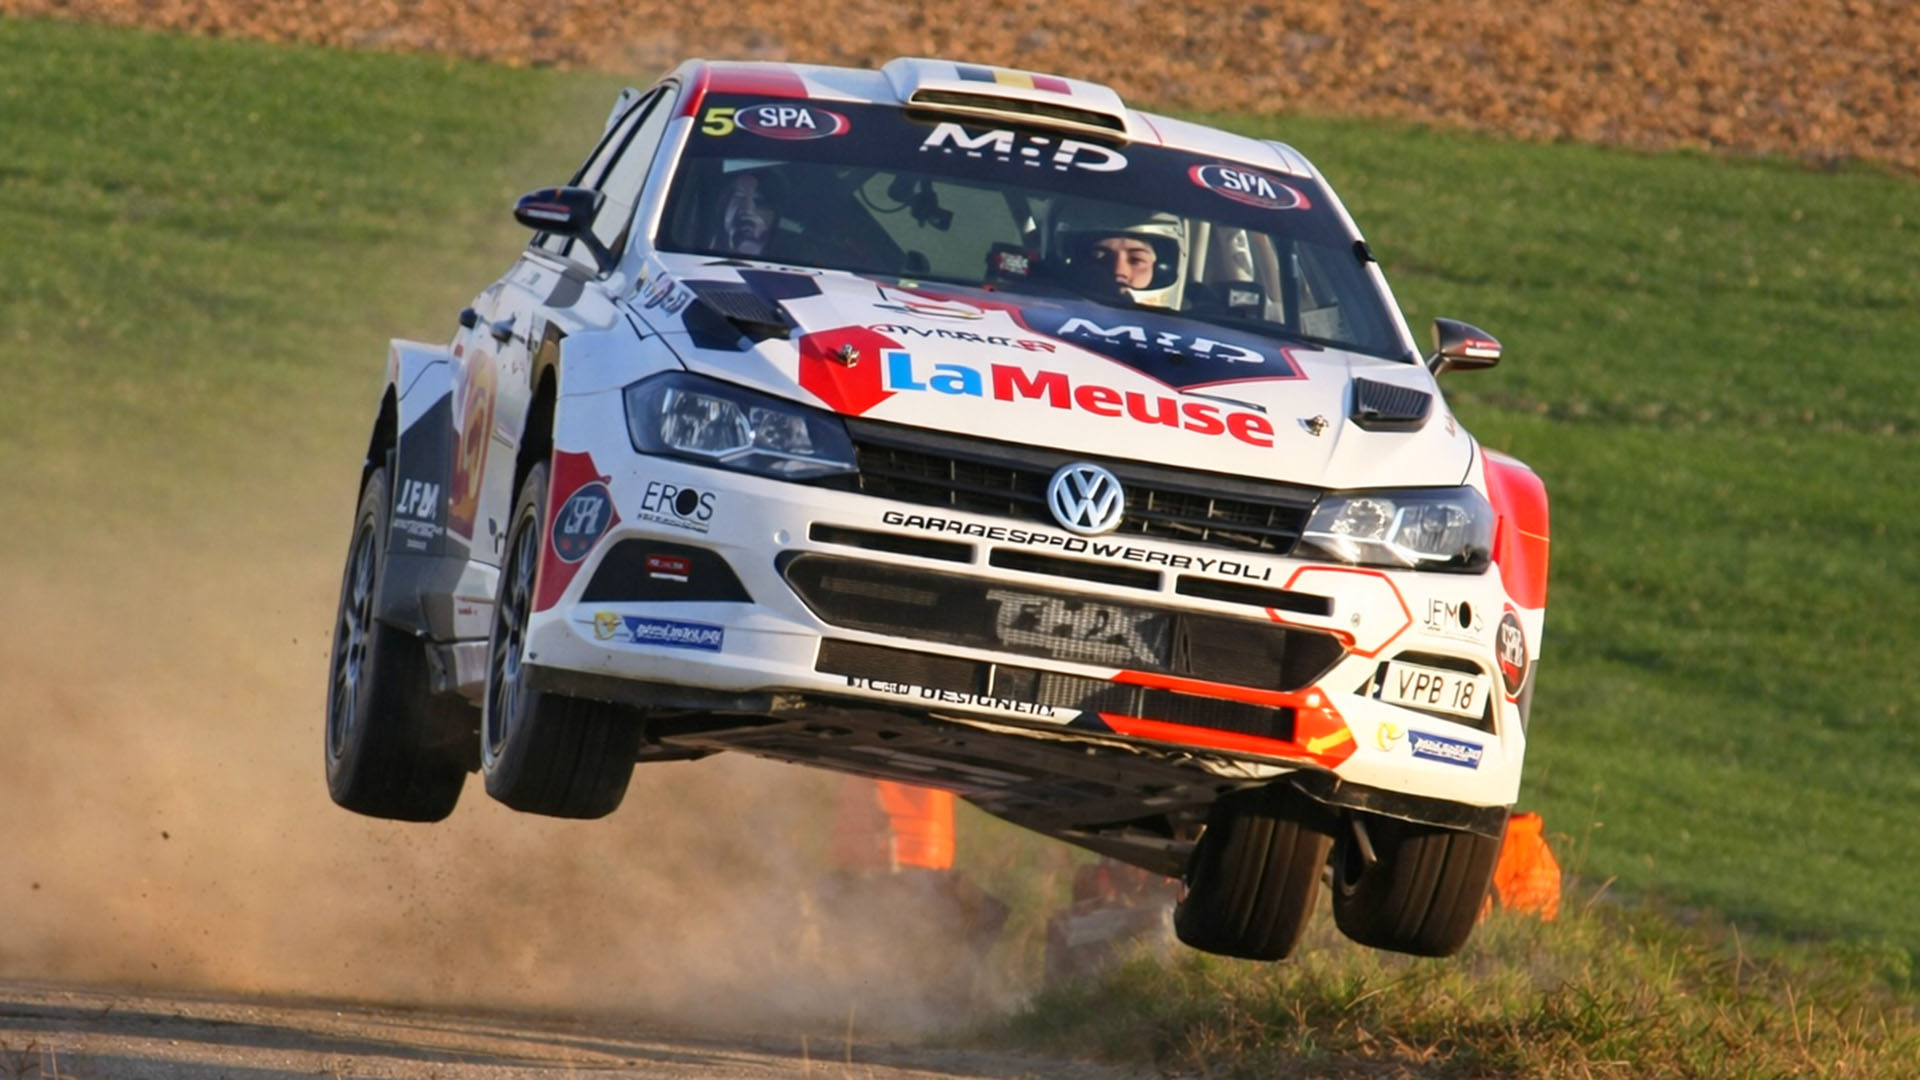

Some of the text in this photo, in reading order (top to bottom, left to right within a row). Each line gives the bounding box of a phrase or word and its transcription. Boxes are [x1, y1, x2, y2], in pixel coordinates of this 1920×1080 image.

[702, 107, 736, 137] 5
[758, 107, 817, 130] SPA
[1219, 168, 1277, 199] SPA
[641, 480, 717, 521] EROS
[1399, 669, 1476, 710] VPB 18
